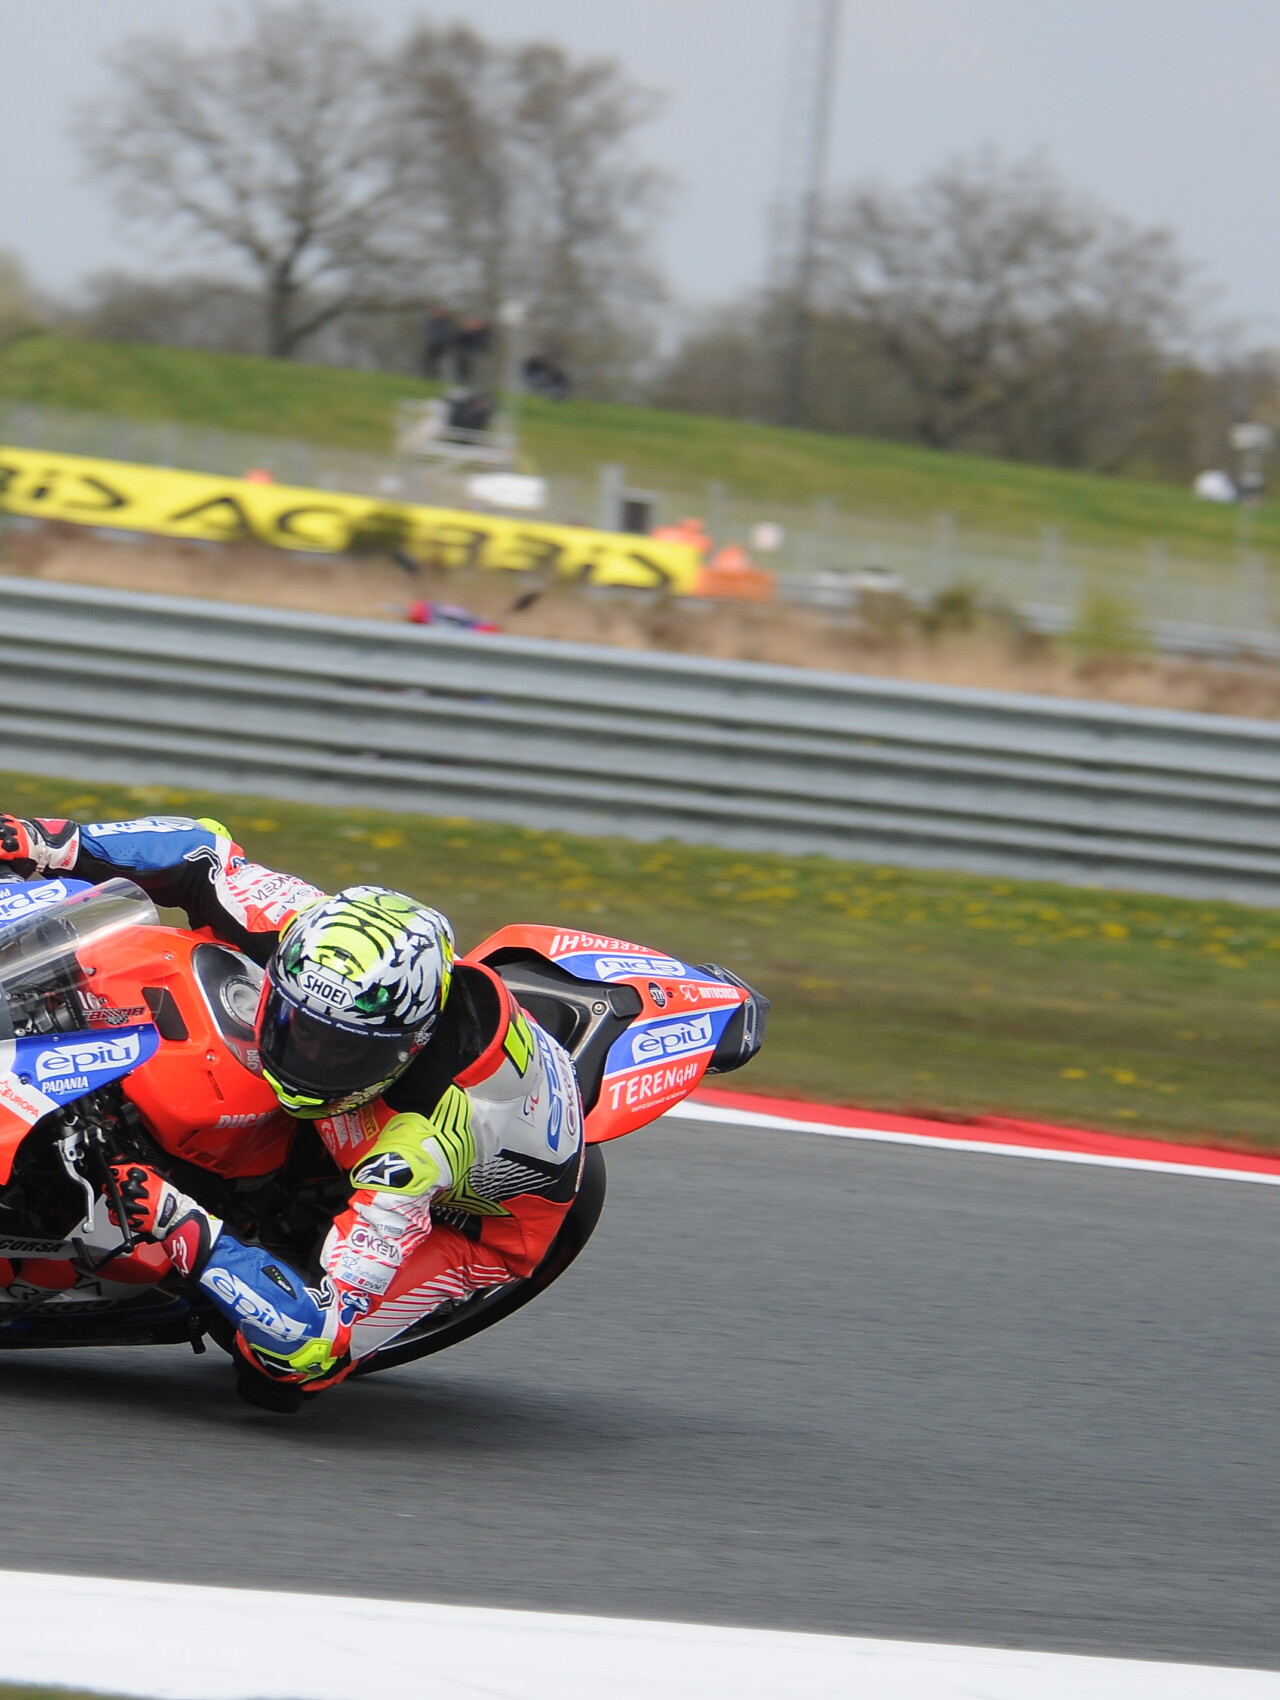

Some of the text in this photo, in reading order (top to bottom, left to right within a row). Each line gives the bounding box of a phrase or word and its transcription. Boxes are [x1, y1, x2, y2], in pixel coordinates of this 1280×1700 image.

[303, 974, 347, 1006] SHOEI
[638, 1026, 708, 1053] epiu
[41, 1044, 135, 1076] epiu
[41, 1076, 89, 1095] PADANIA
[3, 1086, 41, 1119] EUROPA
